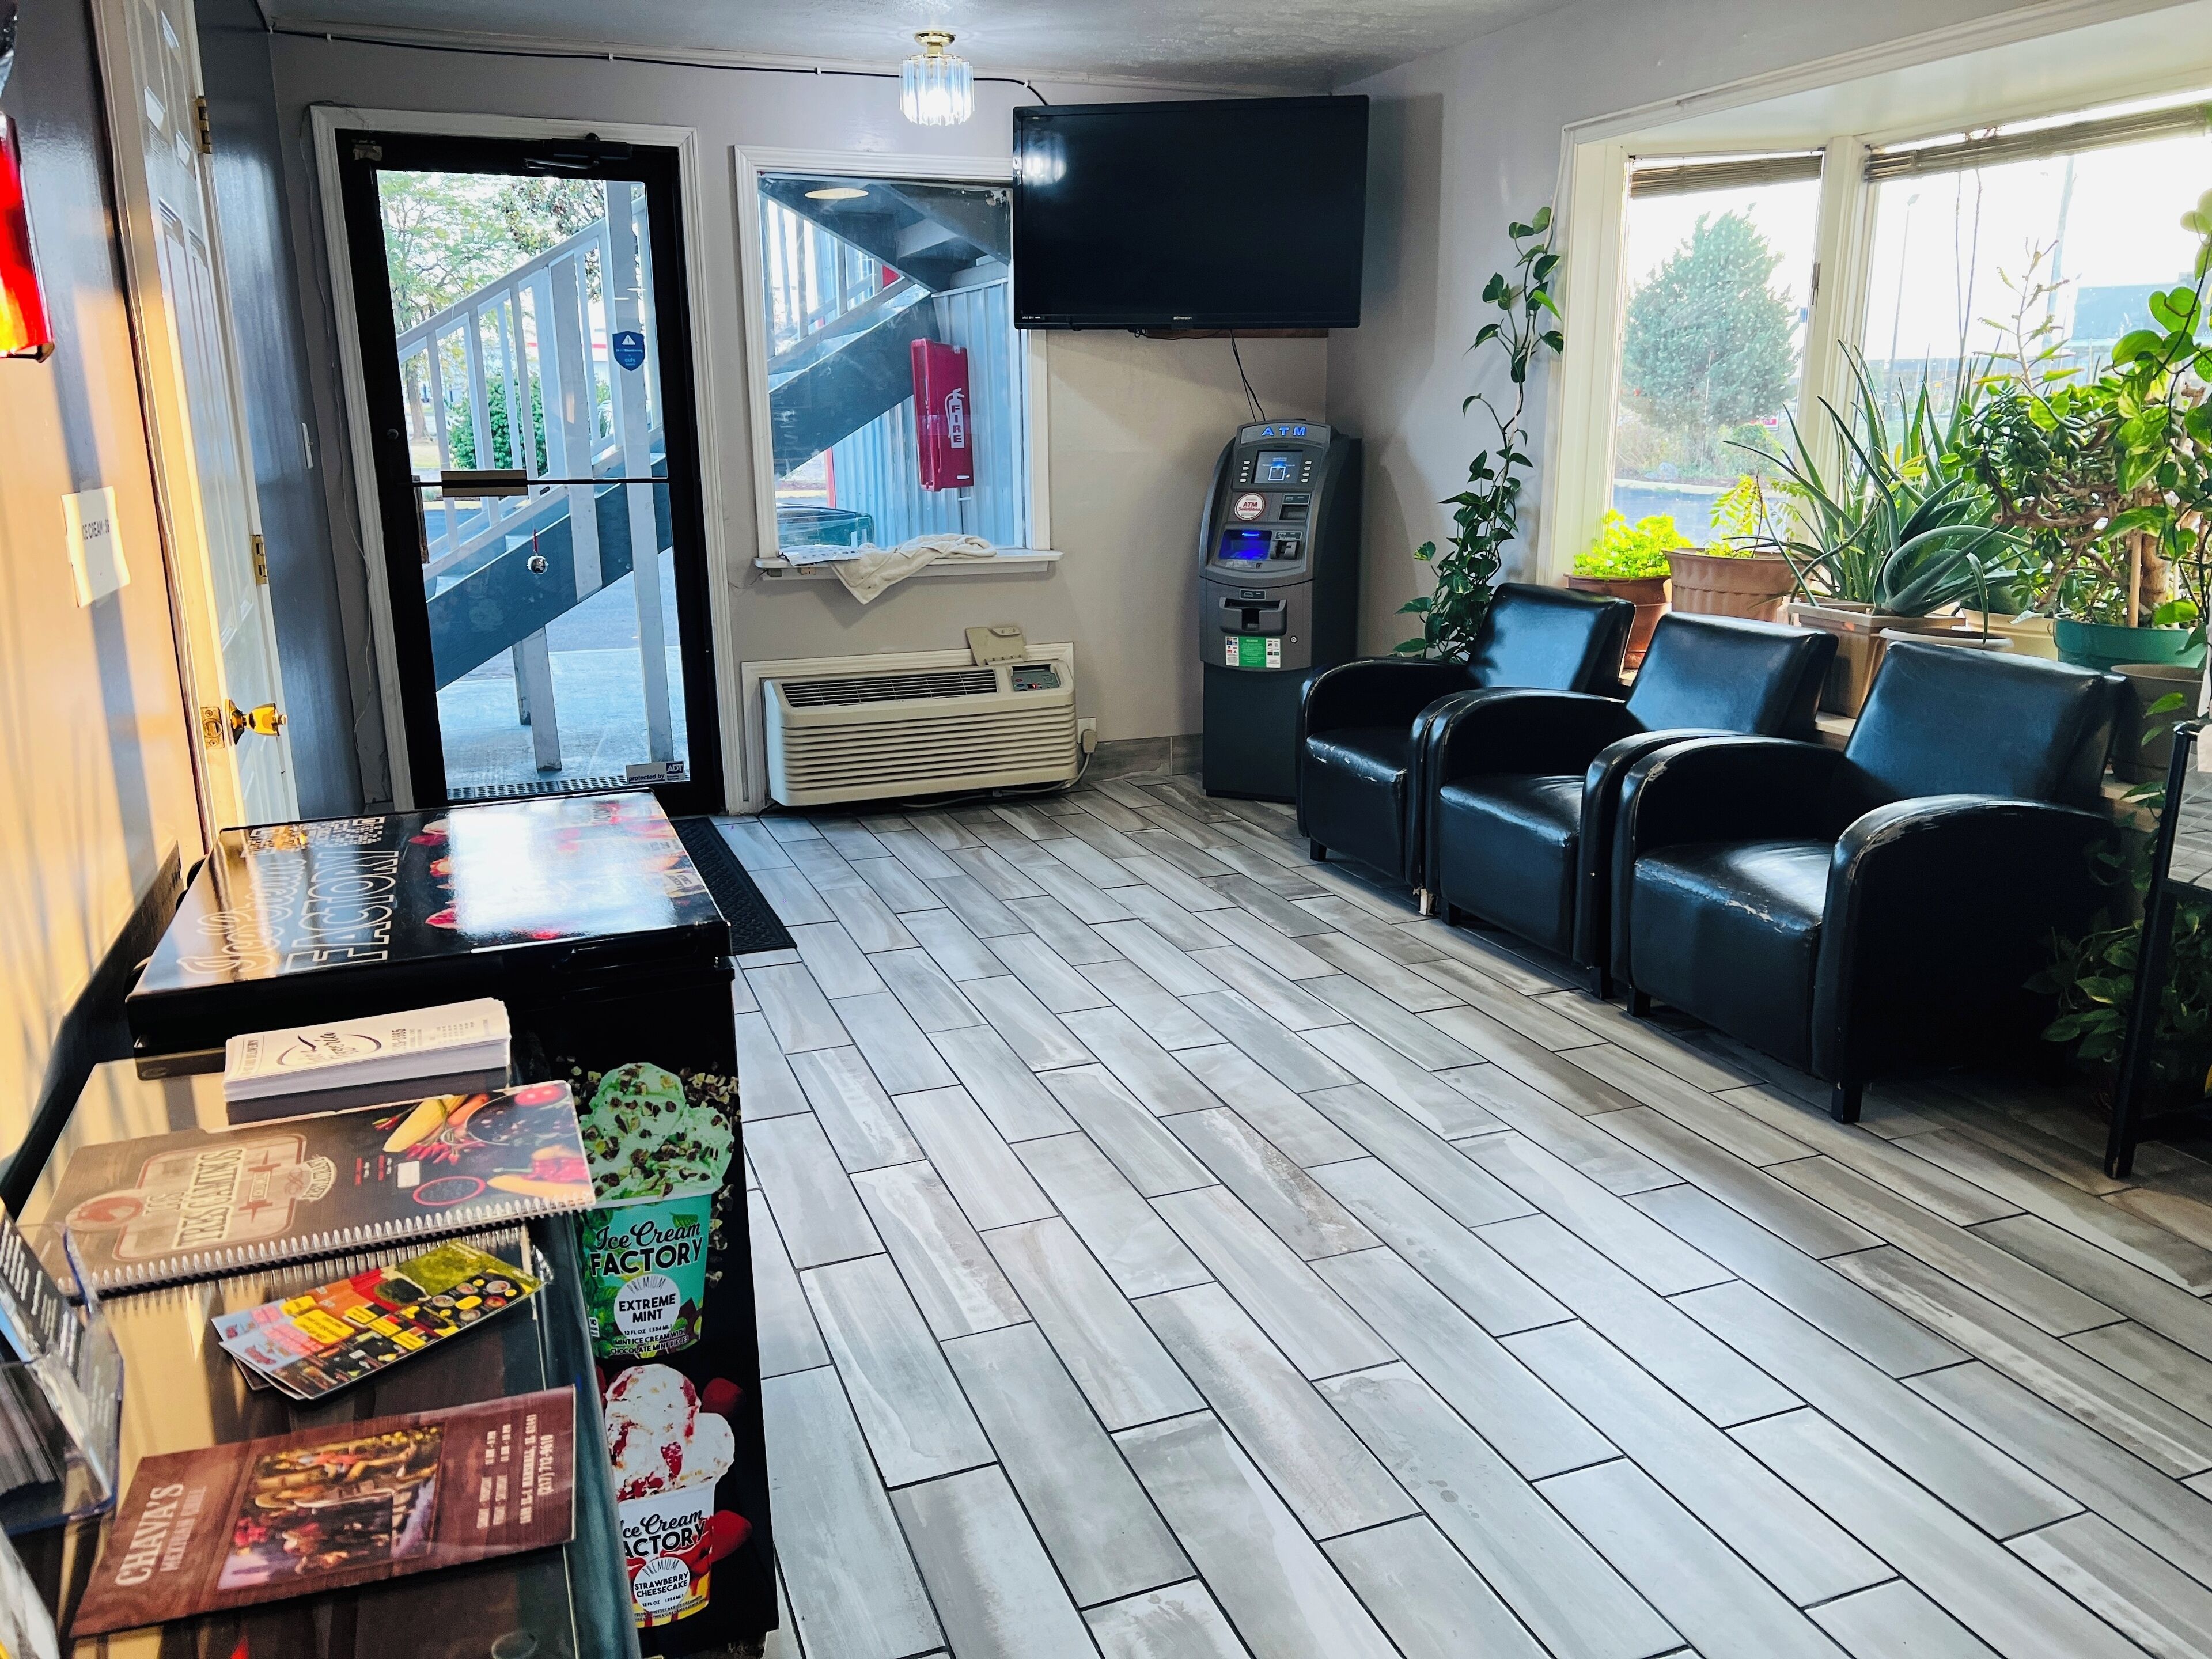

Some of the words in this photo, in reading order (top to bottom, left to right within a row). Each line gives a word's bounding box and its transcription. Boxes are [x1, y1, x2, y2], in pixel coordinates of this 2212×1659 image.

[951, 404, 962, 443] FIRE
[1262, 426, 1306, 436] ATM
[628, 774, 657, 782] protected
[666, 764, 683, 772] ADT
[197, 859, 306, 935] Cream
[285, 850, 399, 973] FACTORY
[176, 925, 285, 974] Ice
[187, 1149, 244, 1208] CAMINOS
[301, 1157, 332, 1200] RESTAURANT
[143, 1191, 185, 1215] LOS
[174, 1207, 232, 1248] TRES
[594, 1226, 632, 1251] Ice
[630, 1221, 700, 1247] Cream
[589, 1237, 703, 1277] FACTORY
[627, 1276, 666, 1294] PREMIUM
[619, 1293, 676, 1312] EXTREME
[632, 1309, 663, 1323] MINT
[610, 1346, 652, 1354] CHOCOLATE
[652, 1343, 669, 1351] MINT
[645, 1333, 669, 1343] CREAM
[671, 1328, 685, 1338] WITH
[539, 1434, 554, 1472] 712-9610
[537, 1472, 555, 1495] (217)
[115, 1484, 184, 1585] CHAVA'S
[620, 1520, 642, 1538] ce
[640, 1510, 704, 1535] Cream
[623, 1521, 706, 1558] ACTORY
[634, 1571, 689, 1590] STRAWBERRY
[642, 1559, 680, 1577] PREMIUM
[636, 1579, 688, 1597] CHEESECAKE
